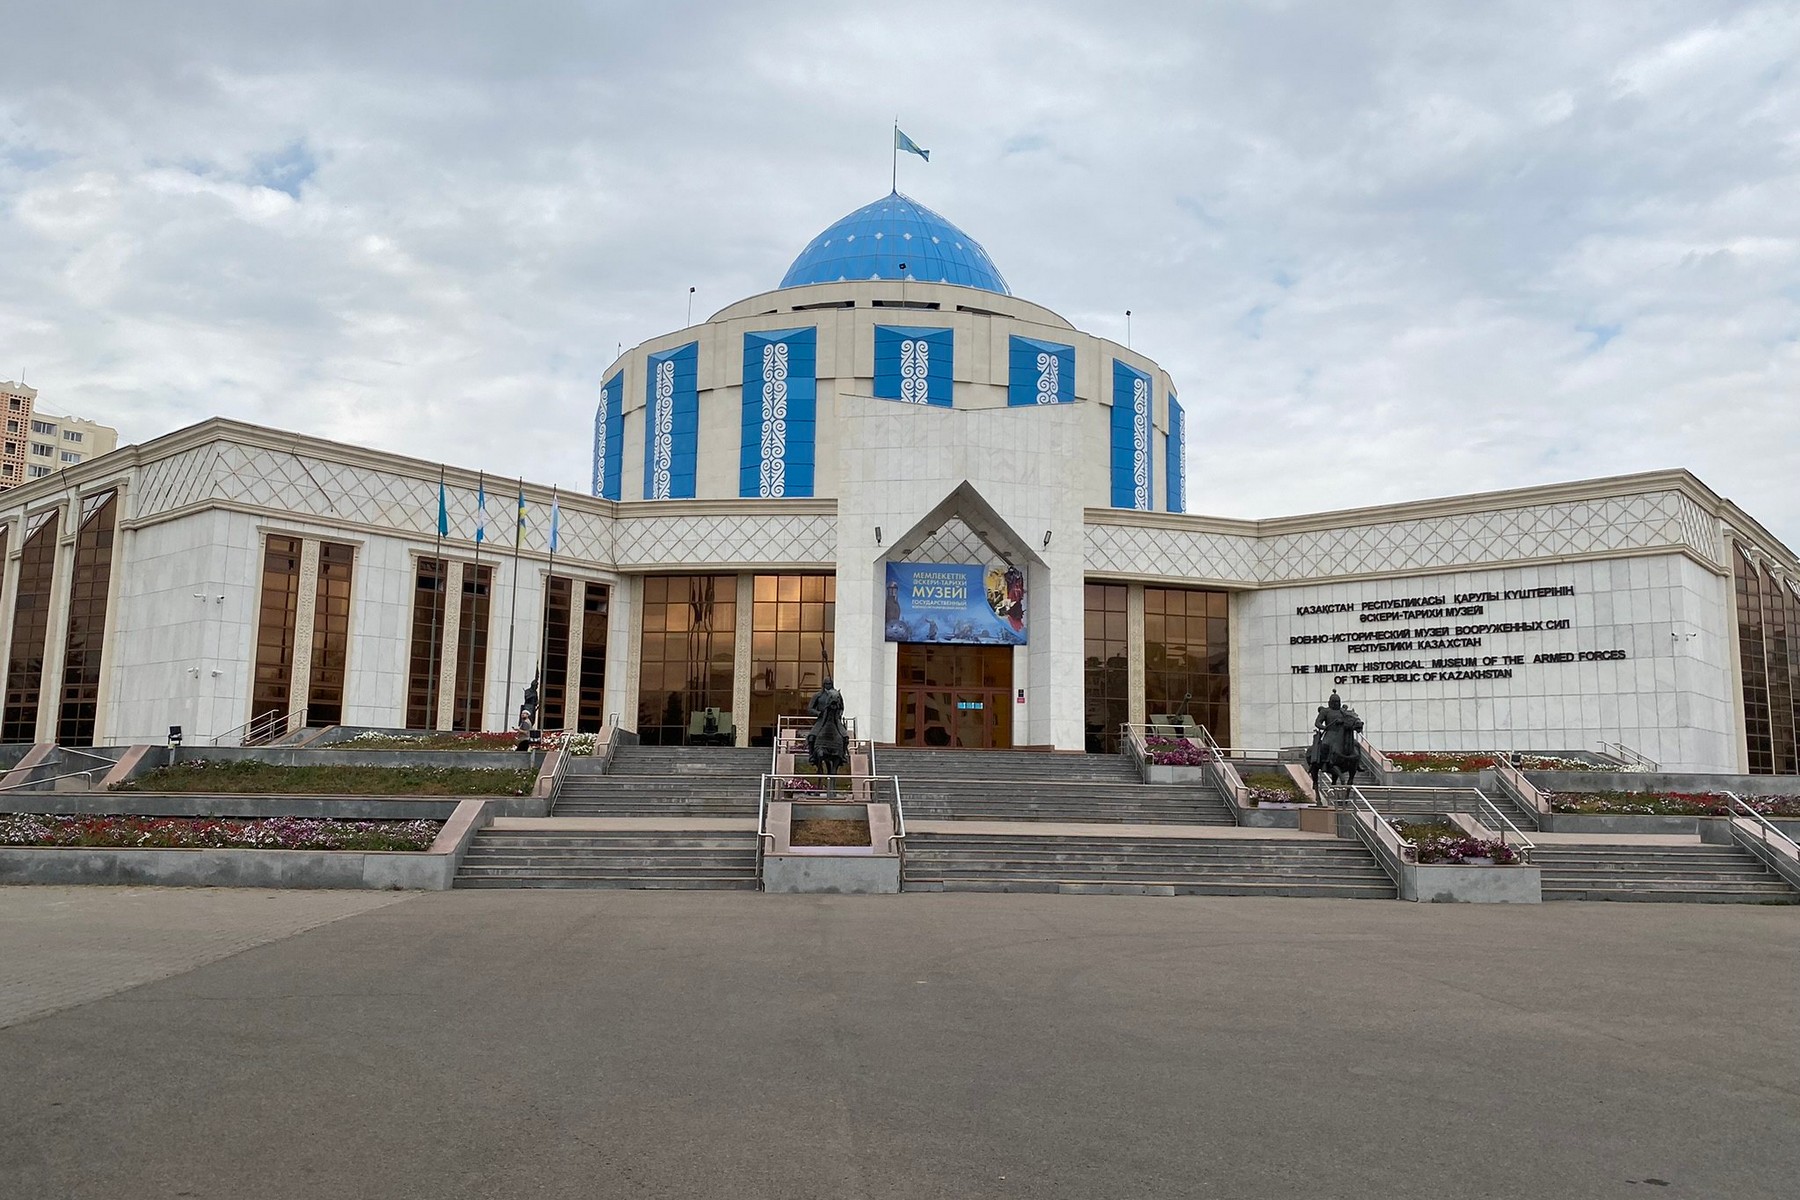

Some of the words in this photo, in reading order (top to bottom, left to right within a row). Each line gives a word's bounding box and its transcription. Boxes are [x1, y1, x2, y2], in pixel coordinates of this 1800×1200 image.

[912, 572, 966, 580] МЕМЛЕКЕТТІК
[912, 586, 967, 598] МУЗЕЙІ
[1297, 603, 1354, 616] ҚАЗАҚСТАН
[1362, 596, 1445, 610] РЕСПУБЛИКАСЫ
[1454, 592, 1499, 604] ҚАРУЛЫ
[1504, 586, 1574, 600] КҮШТЕРІНІҢ
[1360, 608, 1442, 622] ӘСКЕРИ-ТАРИХИ
[1446, 605, 1483, 617] МУЗЕЙІ
[1290, 629, 1410, 645] ВОЕННО-ИСТОРИЧЕСКИЙ
[1415, 627, 1449, 637] МУЗЕЙ
[1456, 621, 1542, 635] ВООРУЖЕННЫХ
[1546, 619, 1570, 629] СИЛ
[1348, 641, 1412, 653] РЕСПУБЛИКИ
[1418, 638, 1481, 649] КАЗАХСТАН
[1291, 665, 1309, 674] THE
[1315, 663, 1358, 673] MILITARY
[1363, 660, 1424, 671] HISTORICAL
[1432, 658, 1477, 668] MUSEUM
[1482, 656, 1497, 666] OF
[1502, 655, 1524, 665] THE
[1533, 653, 1574, 663] ARMED
[1578, 650, 1626, 661] FORCES
[1334, 676, 1347, 684] OF
[1351, 675, 1370, 684] THE
[1372, 673, 1420, 683] REPUBLIC
[1423, 672, 1437, 682] OF
[1439, 669, 1512, 681] KAZAKHSTAN
